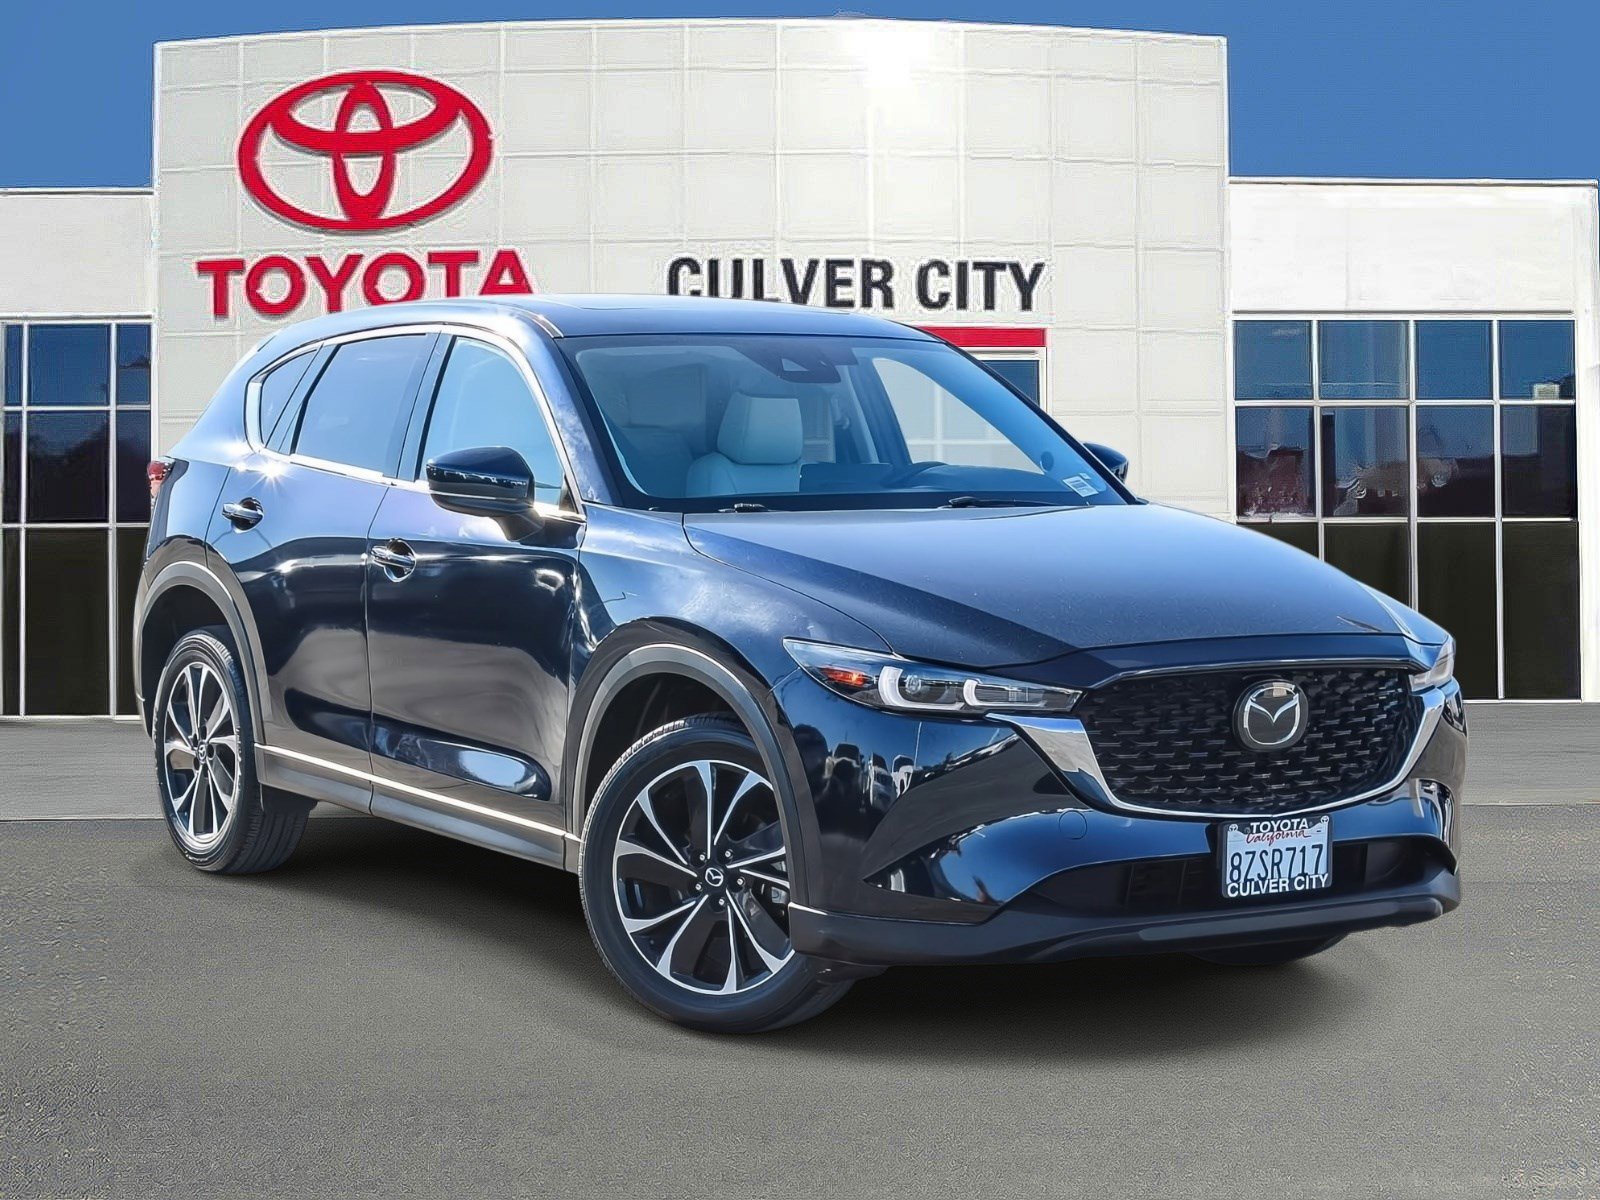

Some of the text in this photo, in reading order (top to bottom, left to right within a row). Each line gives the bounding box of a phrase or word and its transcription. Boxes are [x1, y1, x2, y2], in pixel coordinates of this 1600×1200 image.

[195, 249, 535, 318] TOYOTA
[667, 256, 1046, 312] CULVER CITY
[1245, 829, 1312, 847] California
[1250, 818, 1309, 834] TOYOTA
[1229, 843, 1324, 884] 8ZSR717
[1227, 873, 1329, 898] CULVER CITY
